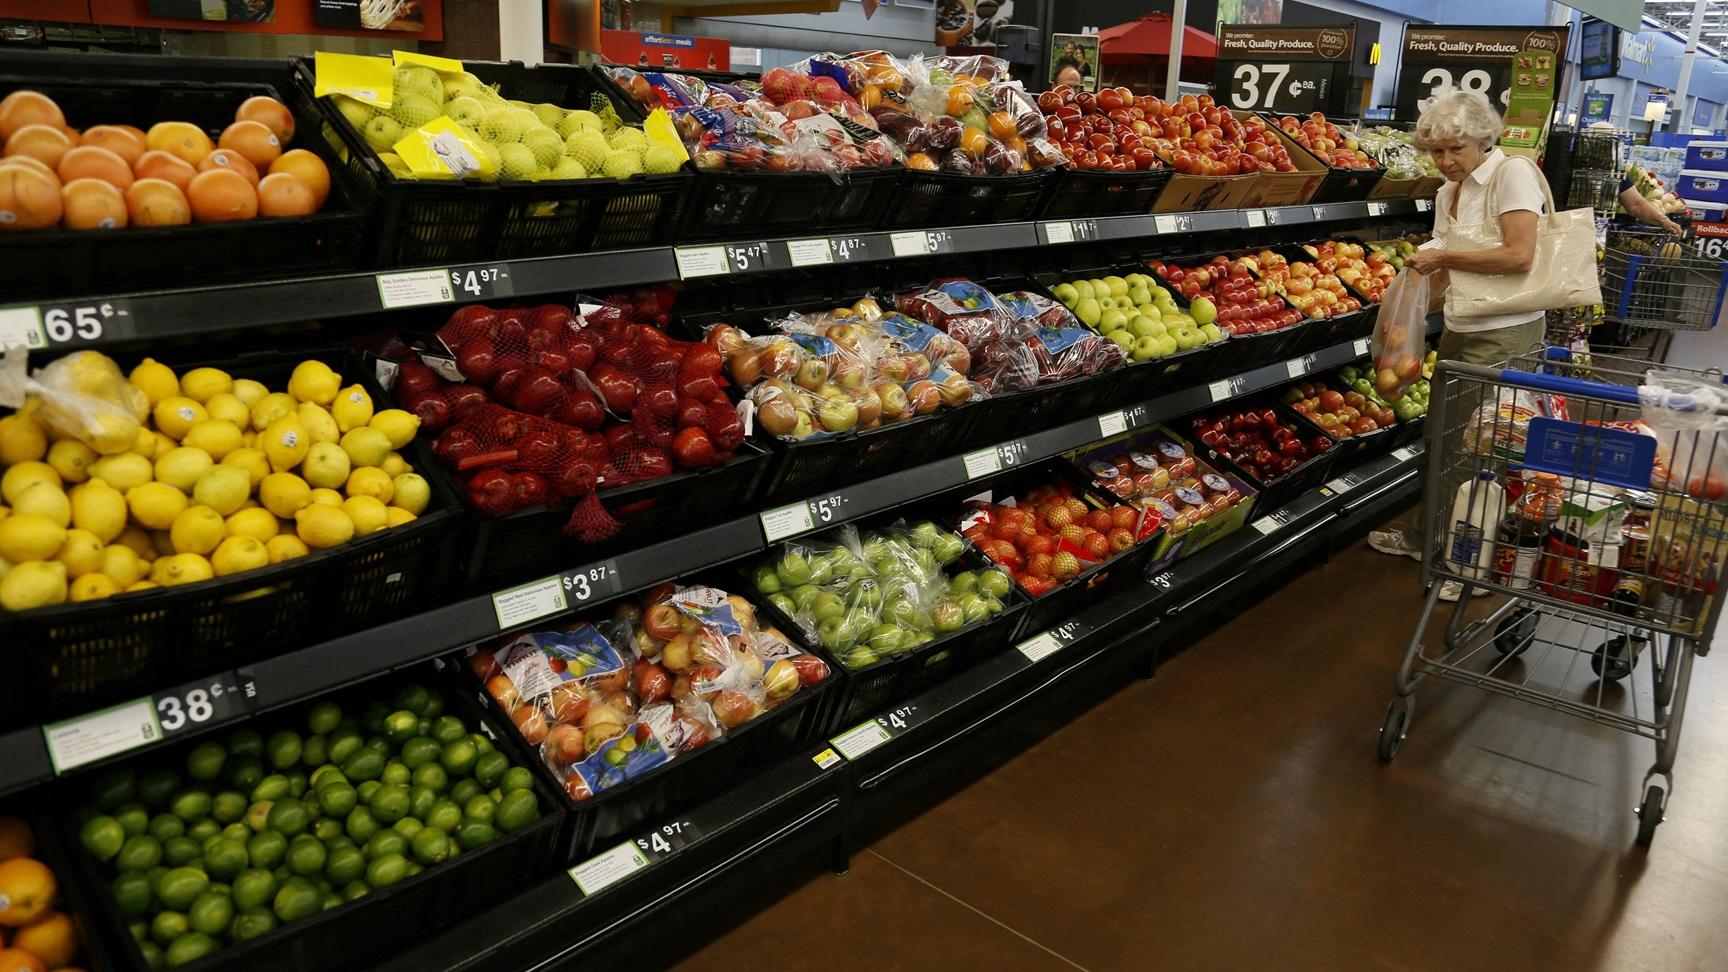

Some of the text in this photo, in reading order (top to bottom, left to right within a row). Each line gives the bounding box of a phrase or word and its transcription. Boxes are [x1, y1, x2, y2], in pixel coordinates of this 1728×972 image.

[1322, 34, 1344, 46] 100%
[1411, 32, 1421, 40] We
[1224, 40, 1247, 48] Fresh,
[1249, 40, 1277, 49] Quality
[1278, 40, 1314, 48] Produce.
[1410, 41, 1519, 53] Fresh, Quality Produce.
[1529, 38, 1556, 50] 100%
[1621, 29, 1648, 65] Walmart
